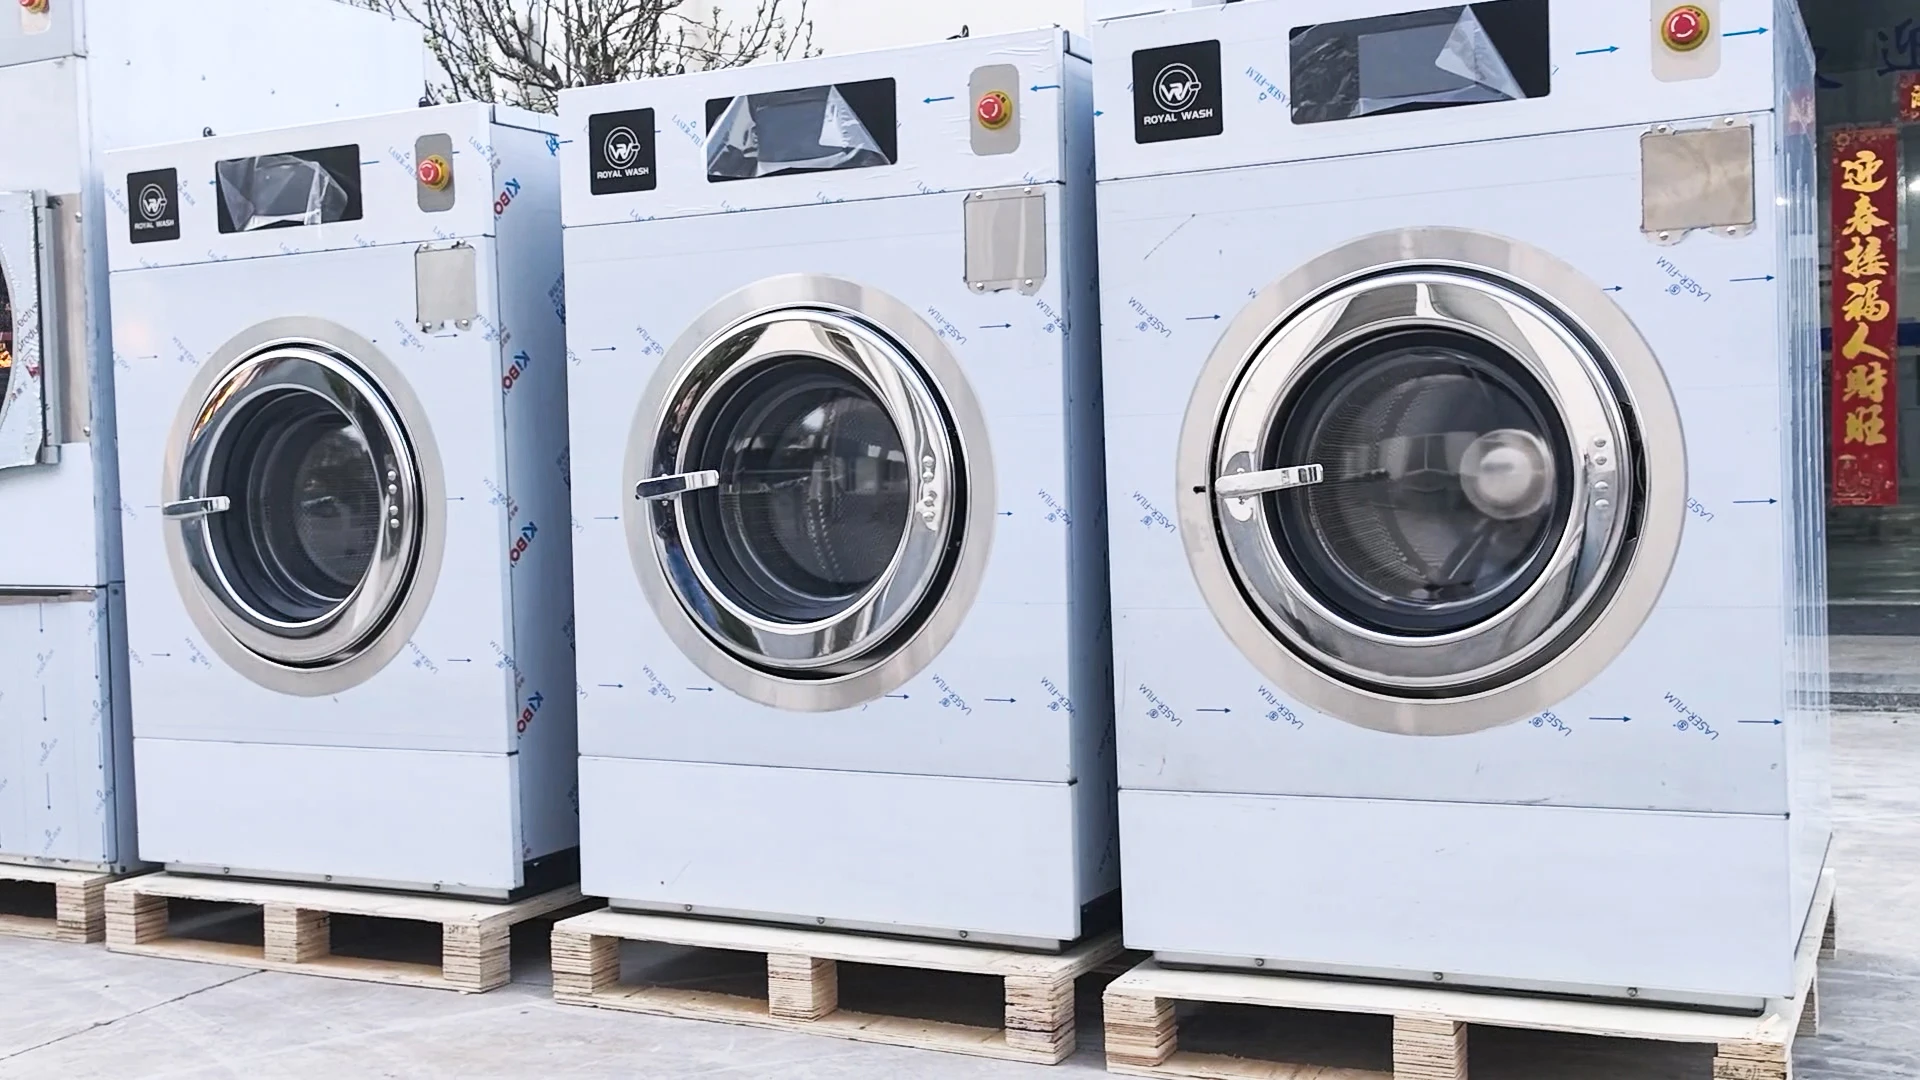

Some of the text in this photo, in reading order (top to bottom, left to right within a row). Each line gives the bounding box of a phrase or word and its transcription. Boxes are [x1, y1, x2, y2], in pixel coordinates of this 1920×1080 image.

[1143, 108, 1213, 125] ROYAL WASH
[597, 167, 650, 179] ROYAL WASH
[134, 219, 175, 230] ROYAL WASH
[1656, 255, 1712, 302] LASER-FILM
[928, 305, 967, 345] LASER-FILM
[1128, 296, 1172, 338] LASER-FILM
[1132, 490, 1177, 533] LASER-FILM
[642, 664, 677, 703] LASER-FILM
[932, 673, 973, 716] LASER-FILM
[1138, 683, 1183, 728] LASER-FILM
[1258, 684, 1304, 730] LASER-FILM
[1664, 691, 1720, 741] LASER-FILM
